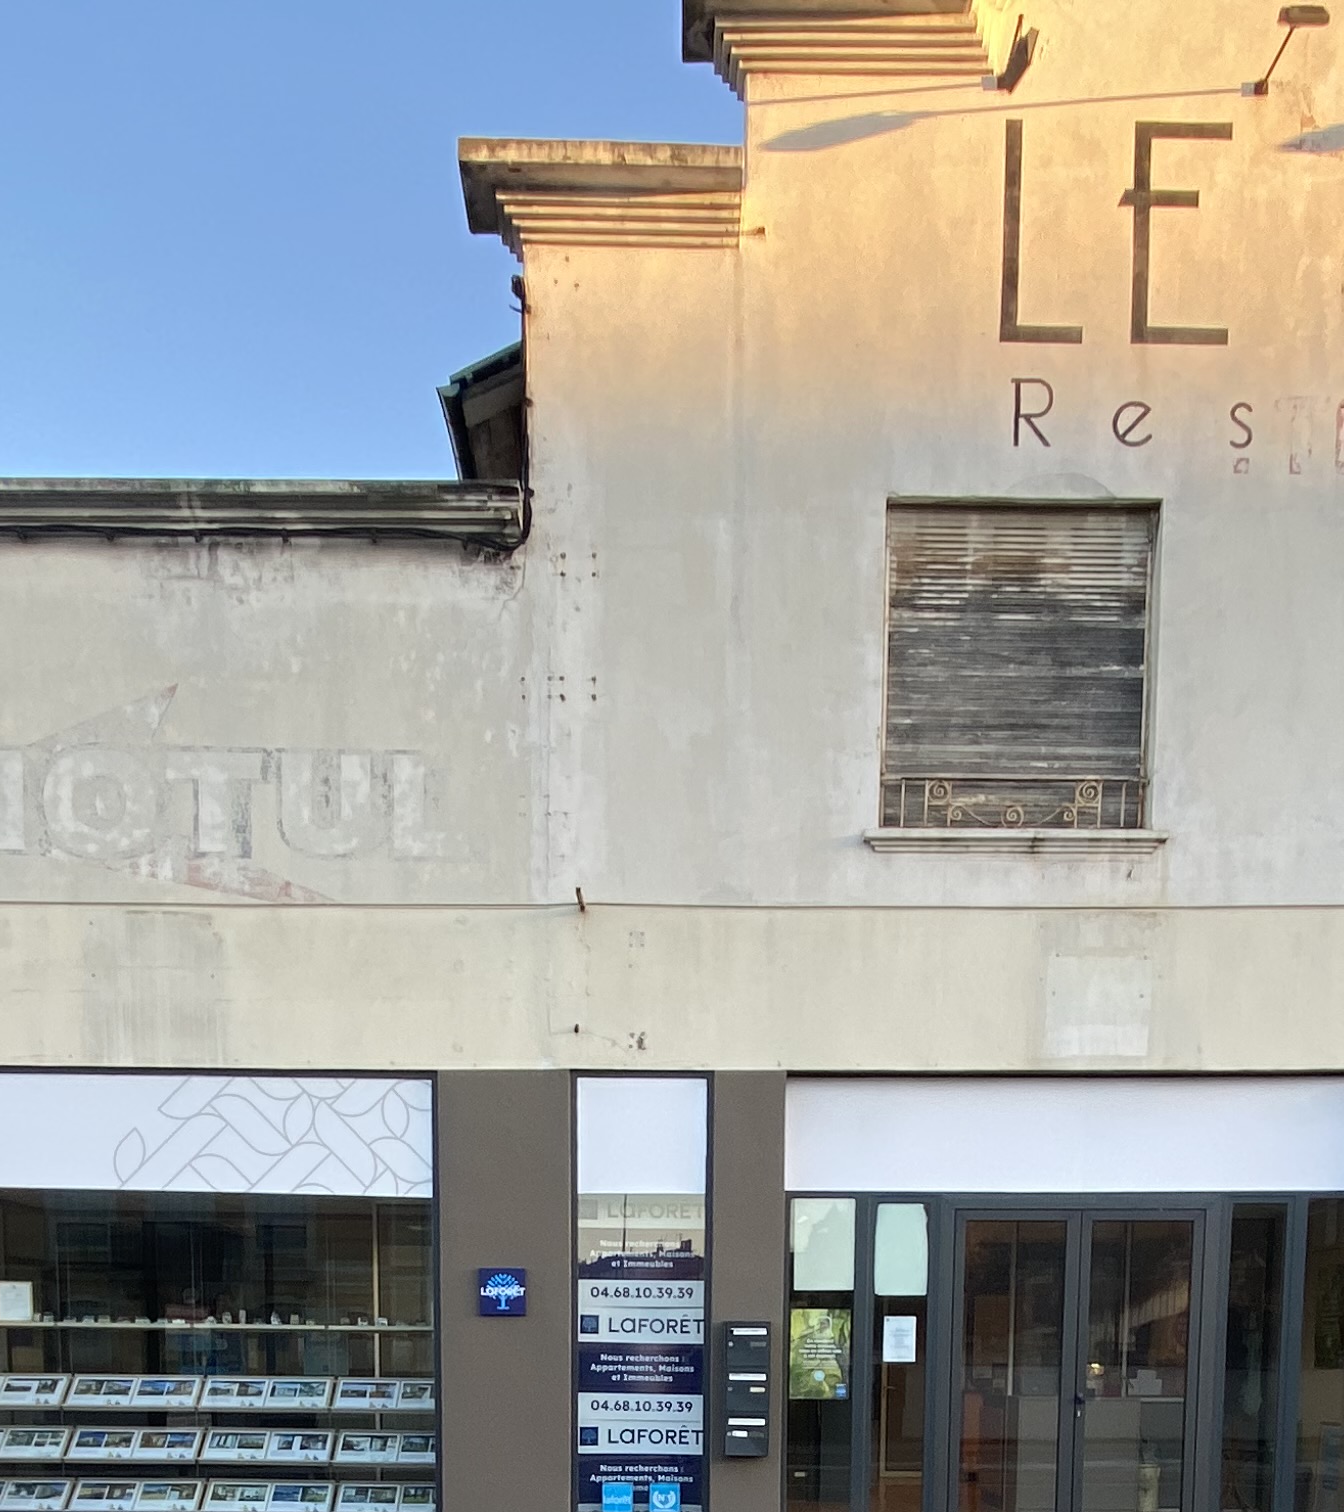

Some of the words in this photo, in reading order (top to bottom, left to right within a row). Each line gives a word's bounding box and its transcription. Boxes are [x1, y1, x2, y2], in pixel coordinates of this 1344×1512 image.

[999, 119, 1234, 345] LE
[611, 1260, 621, 1268] et
[590, 1286, 694, 1299] 04.68.10.39.39
[600, 1353, 623, 1362] Nous
[625, 1354, 679, 1362] recherchons
[590, 1363, 656, 1373] Appartements,
[658, 1363, 694, 1373] Maisons
[623, 1374, 674, 1382] Immeubles
[590, 1400, 693, 1412] 04.68.10.39.39
[599, 1464, 623, 1472] Nous
[624, 1464, 679, 1472] recherchons
[589, 1474, 656, 1483] Appartements,
[657, 1474, 694, 1483] Maisons
